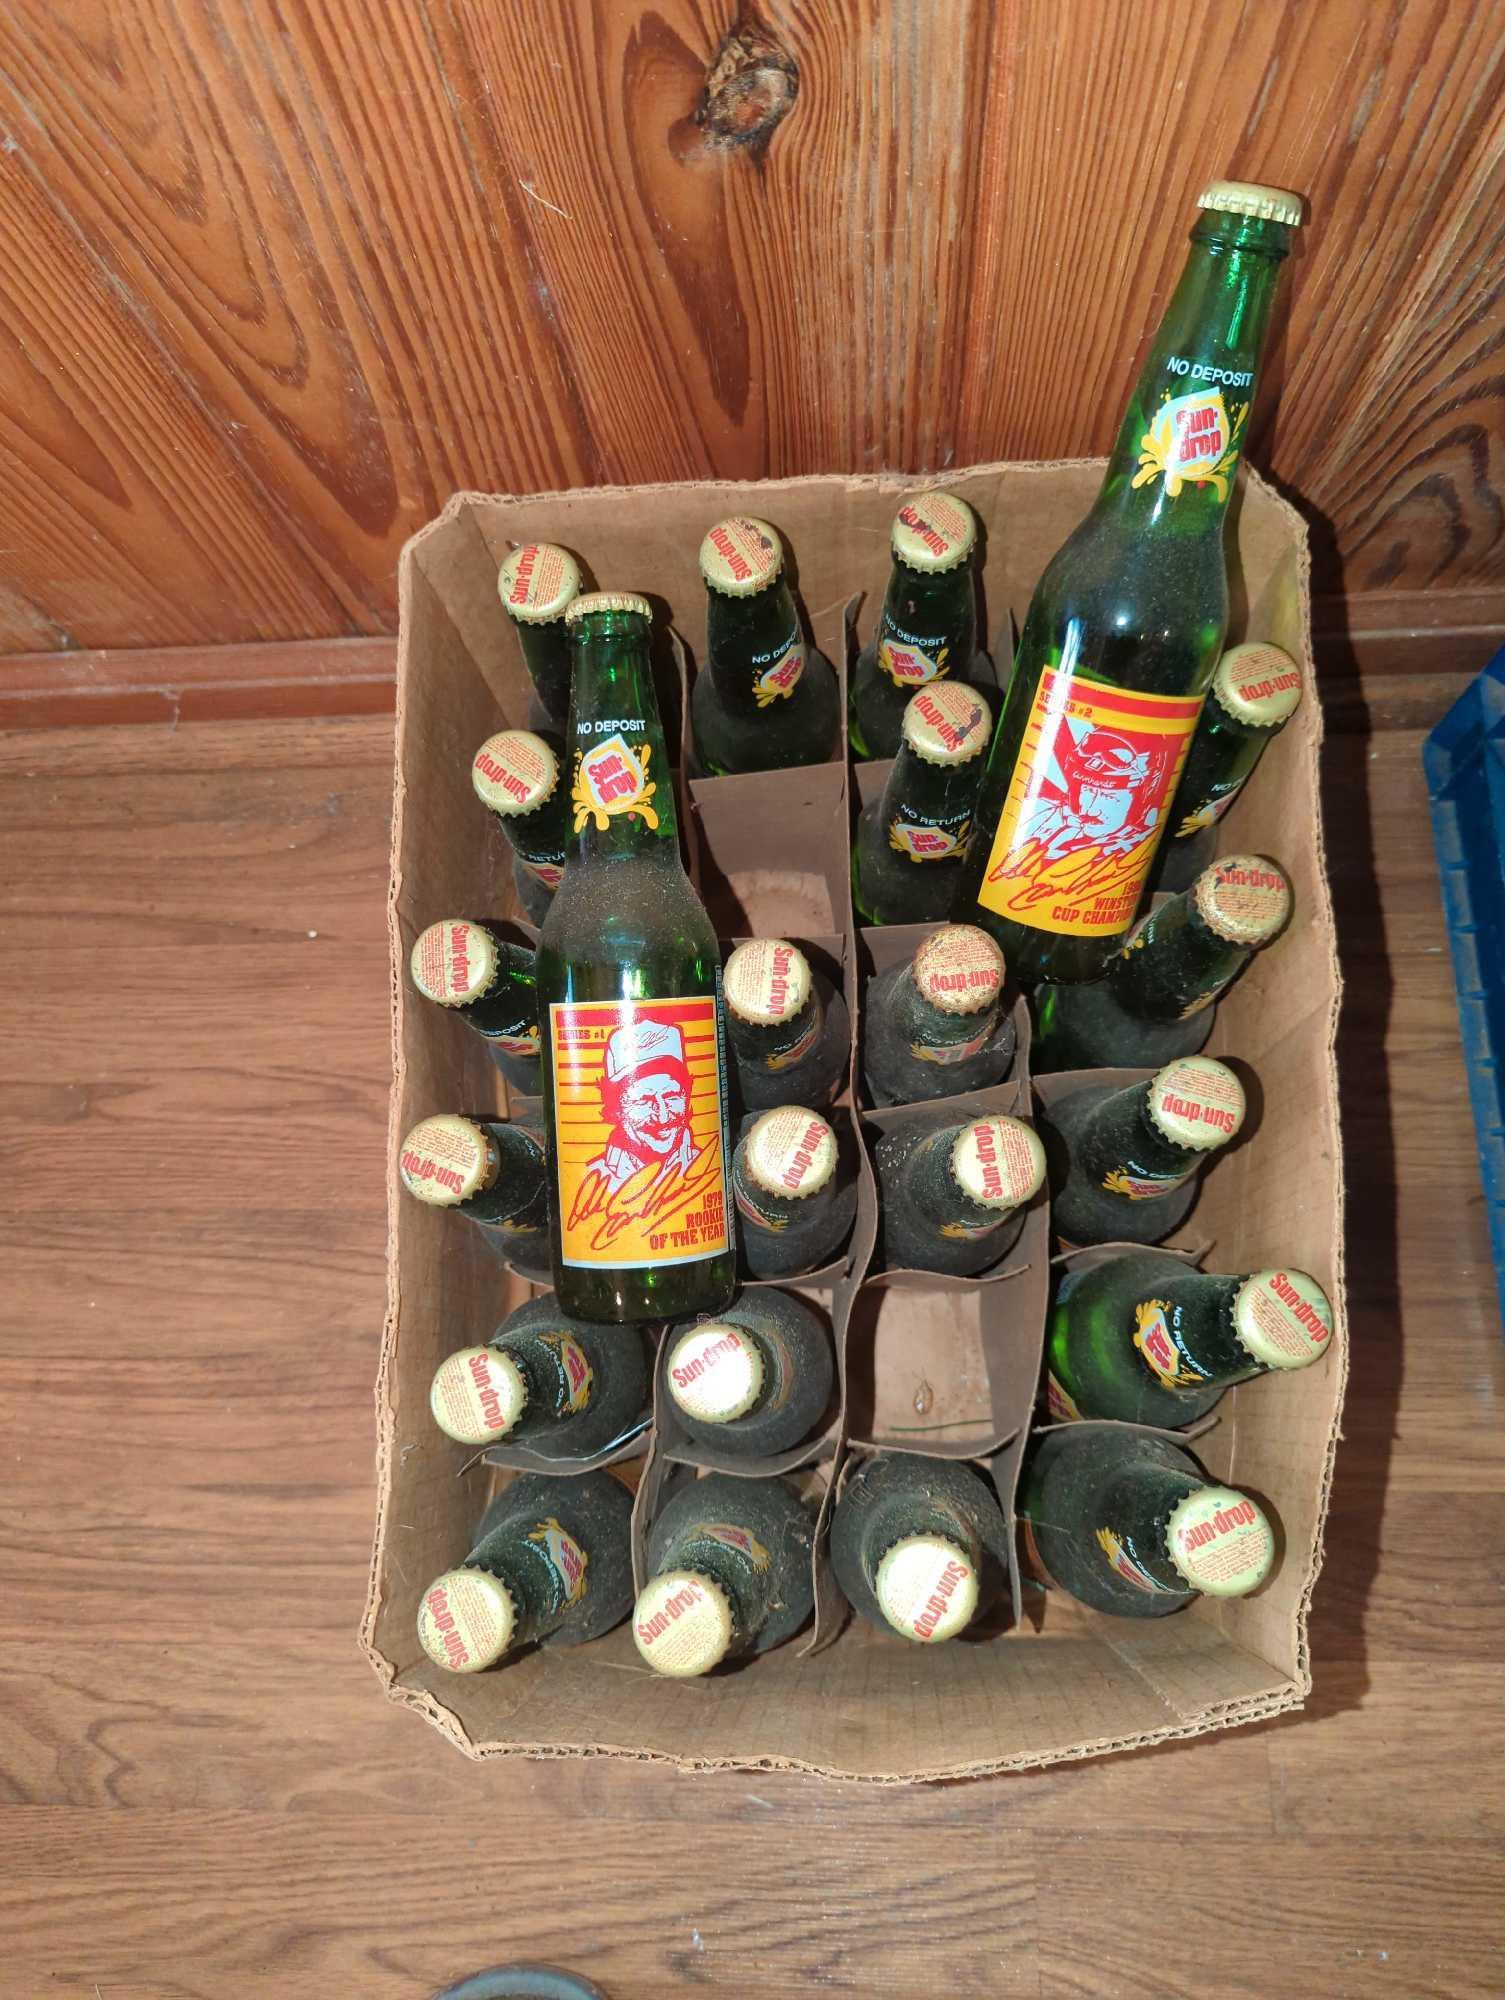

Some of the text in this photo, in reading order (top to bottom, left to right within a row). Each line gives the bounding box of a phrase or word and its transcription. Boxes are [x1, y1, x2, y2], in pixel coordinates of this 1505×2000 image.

[1166, 356, 1254, 387] NO DEPOSIT
[1179, 430, 1221, 461] drop
[896, 628, 947, 646] DEPOSIT
[752, 654, 771, 664] NO
[577, 720, 646, 735] NO DEPOSIT
[901, 804, 971, 826] NO RETURN
[1094, 895, 1138, 911] WINST
[1052, 905, 1081, 922] CUP
[703, 1190, 723, 1209] 1979
[686, 1206, 724, 1229] ROOKIE
[650, 1222, 725, 1250] OF THE YEAR
[1173, 1306, 1214, 1377] NO RETURN
